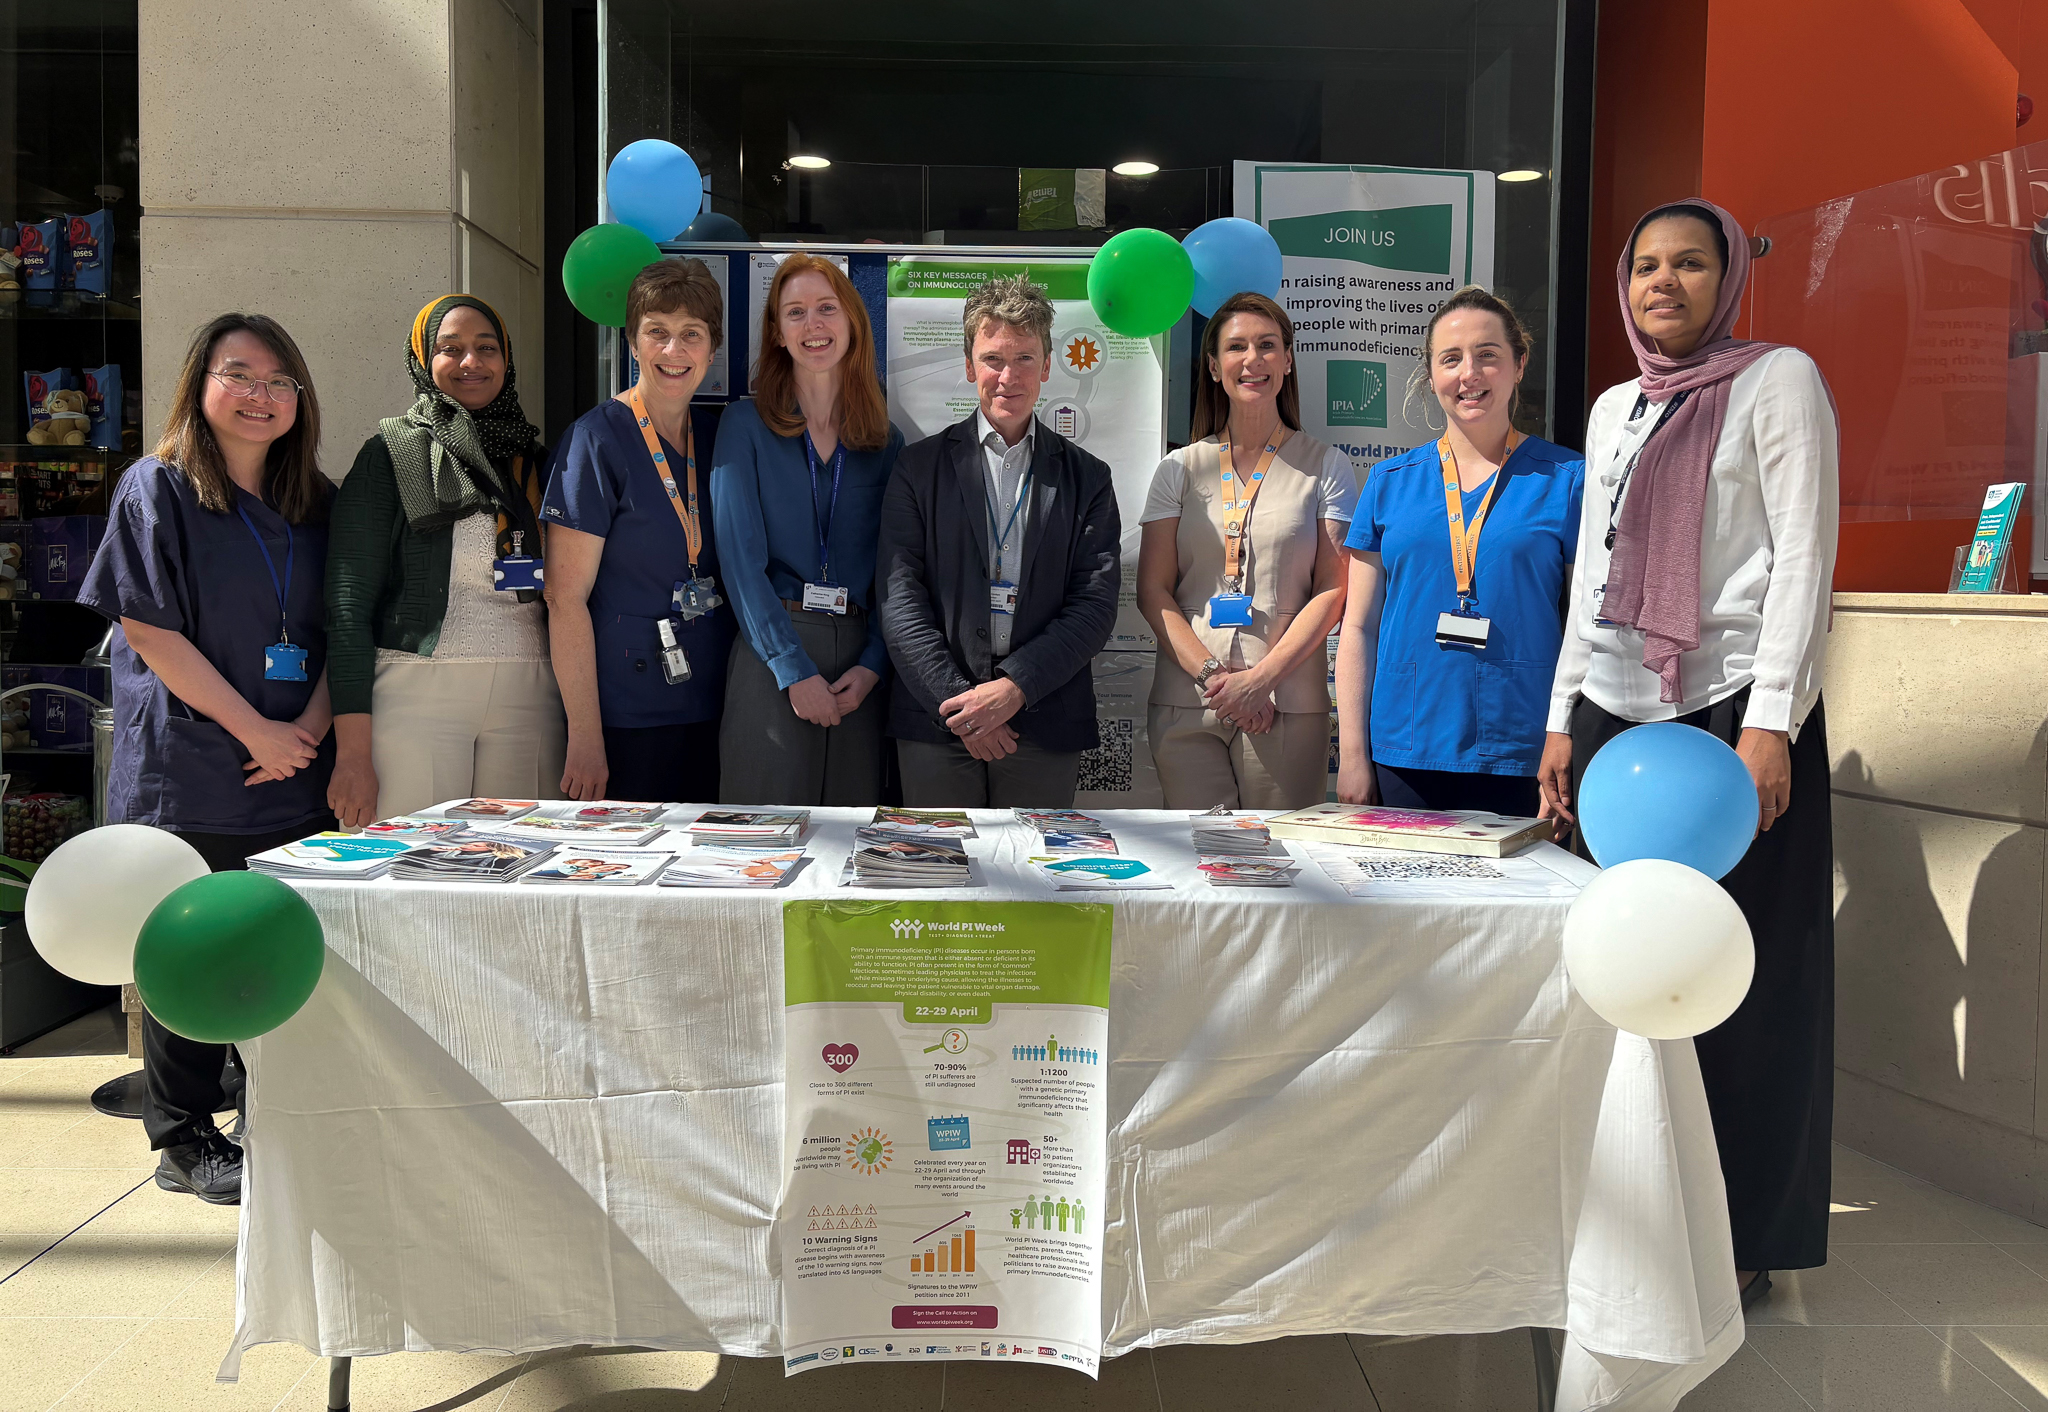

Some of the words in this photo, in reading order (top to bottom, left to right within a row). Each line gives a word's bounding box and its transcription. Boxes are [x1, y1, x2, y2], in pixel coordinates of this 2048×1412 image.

[1324, 228, 1366, 244] JOIN
[1372, 231, 1395, 246] US
[73, 249, 93, 258] Roses
[24, 257, 44, 266] Roses
[942, 272, 987, 280] MESSAGES
[1295, 275, 1345, 289] raising
[1349, 279, 1421, 291] awareness
[1426, 279, 1454, 291] and
[1287, 297, 1362, 311] improving
[1366, 298, 1386, 311] the
[1390, 300, 1423, 312] lives
[1291, 318, 1345, 333] people
[1349, 318, 1377, 331] with
[1380, 320, 1428, 336] primar
[1333, 401, 1354, 410] IPIA
[1333, 444, 1381, 457] World
[1385, 446, 1397, 458] PI
[950, 1007, 978, 1017] April
[827, 1054, 854, 1065] 300
[1069, 1355, 1083, 1364] PPTA
